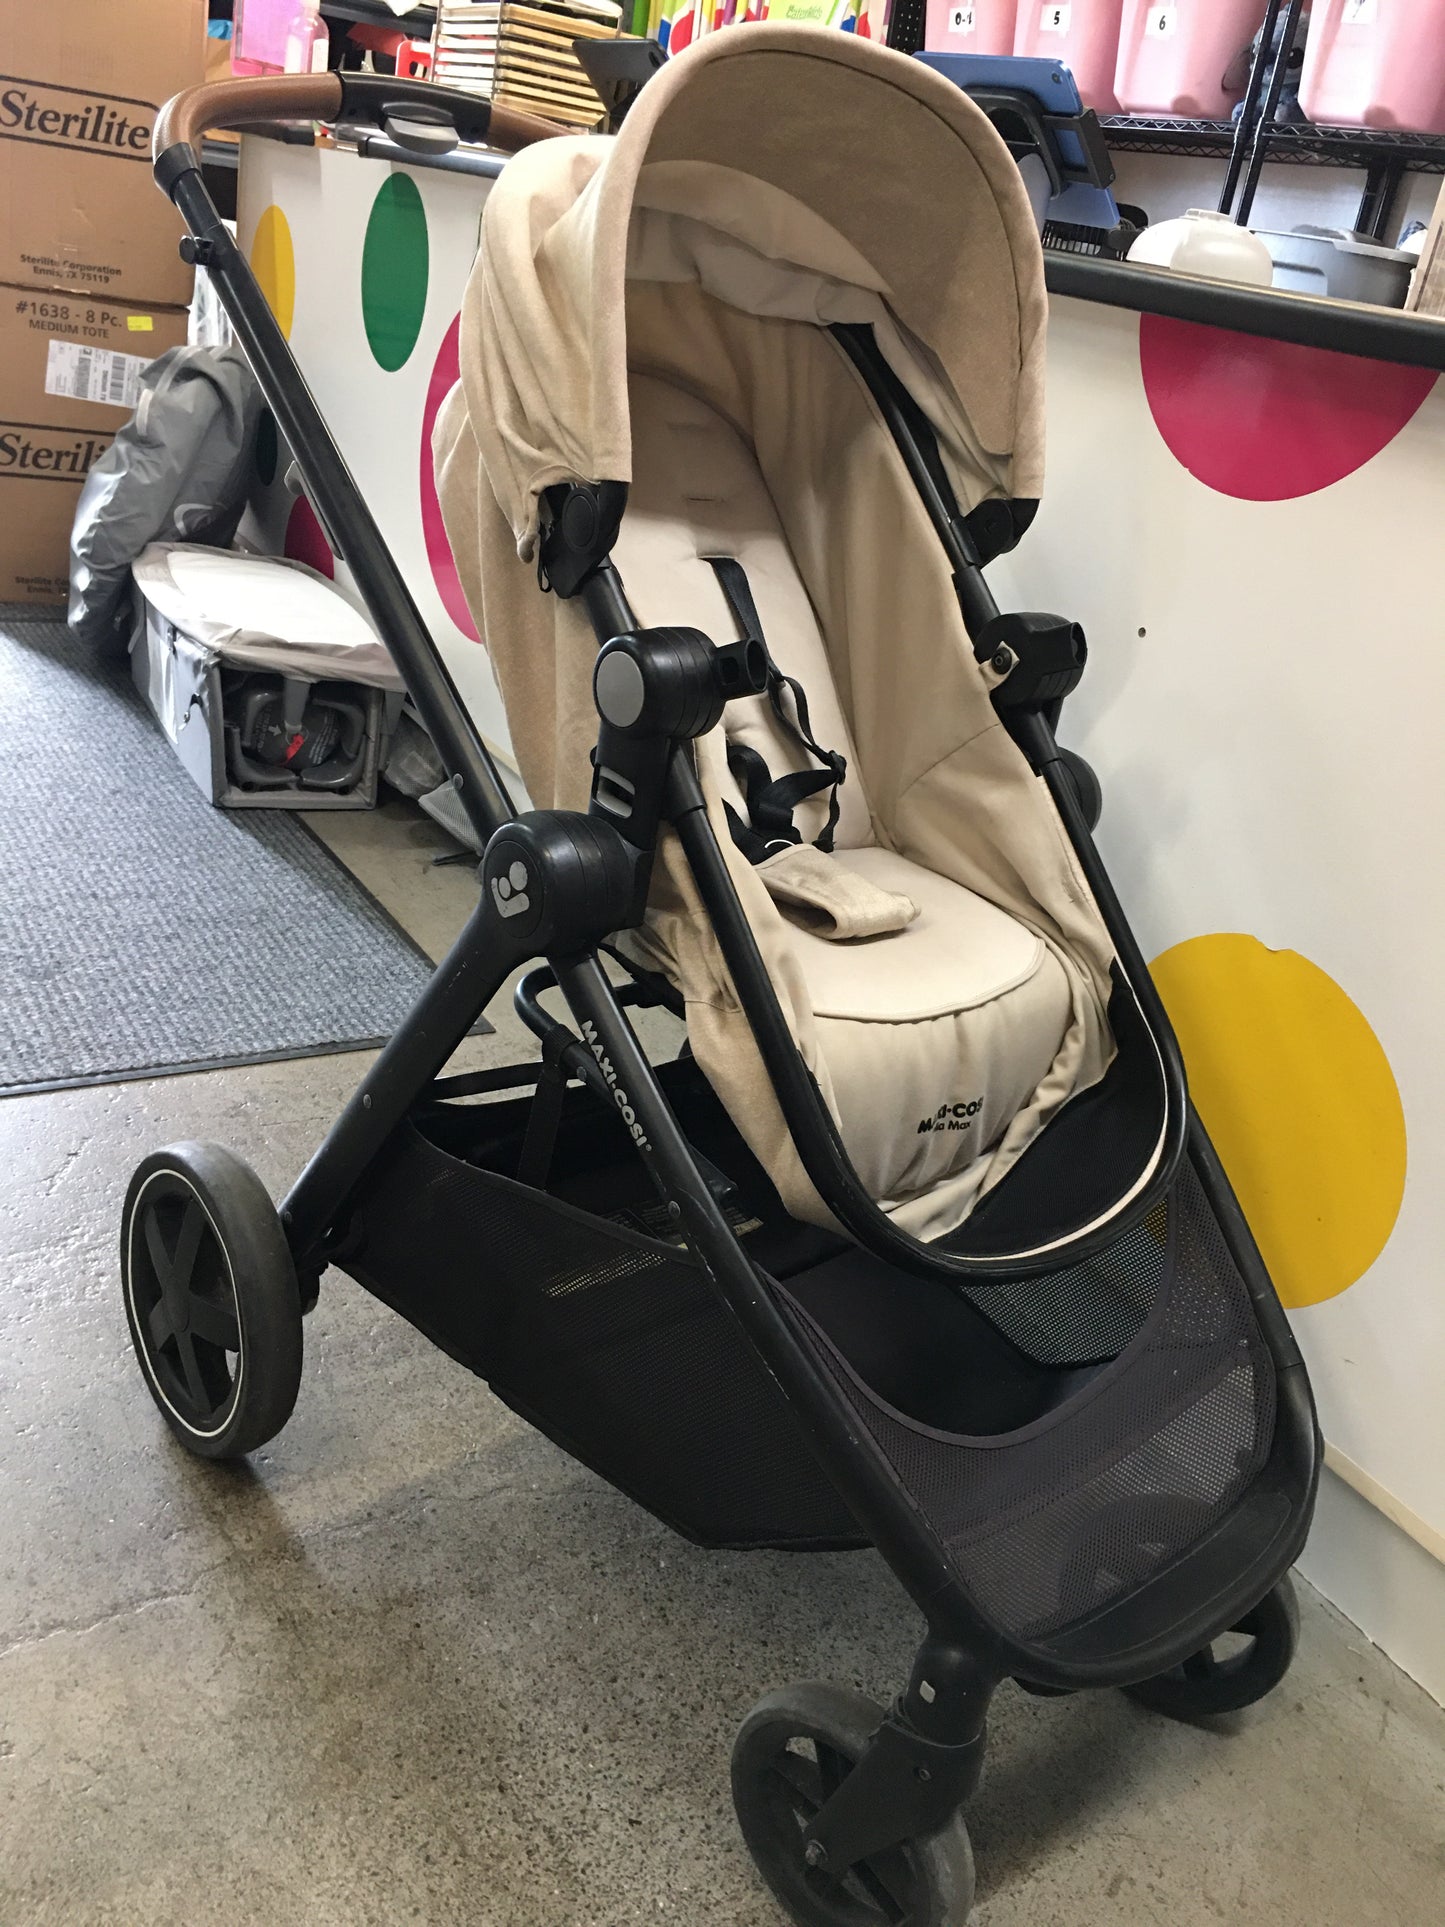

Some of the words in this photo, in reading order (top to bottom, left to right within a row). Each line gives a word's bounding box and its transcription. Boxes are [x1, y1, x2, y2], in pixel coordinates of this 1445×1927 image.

[1053, 11, 1060, 25] 5
[1159, 15, 1166, 30] 6
[0, 90, 150, 150] Sterilite
[81, 272, 110, 284] 75119
[16, 301, 69, 320] #1638
[86, 309, 95, 323] 8
[101, 312, 122, 328] Pc.
[29, 319, 78, 335] MEDIUM
[82, 326, 110, 338] TOTE
[0, 433, 106, 473] Sterili
[948, 1120, 971, 1131] Max
